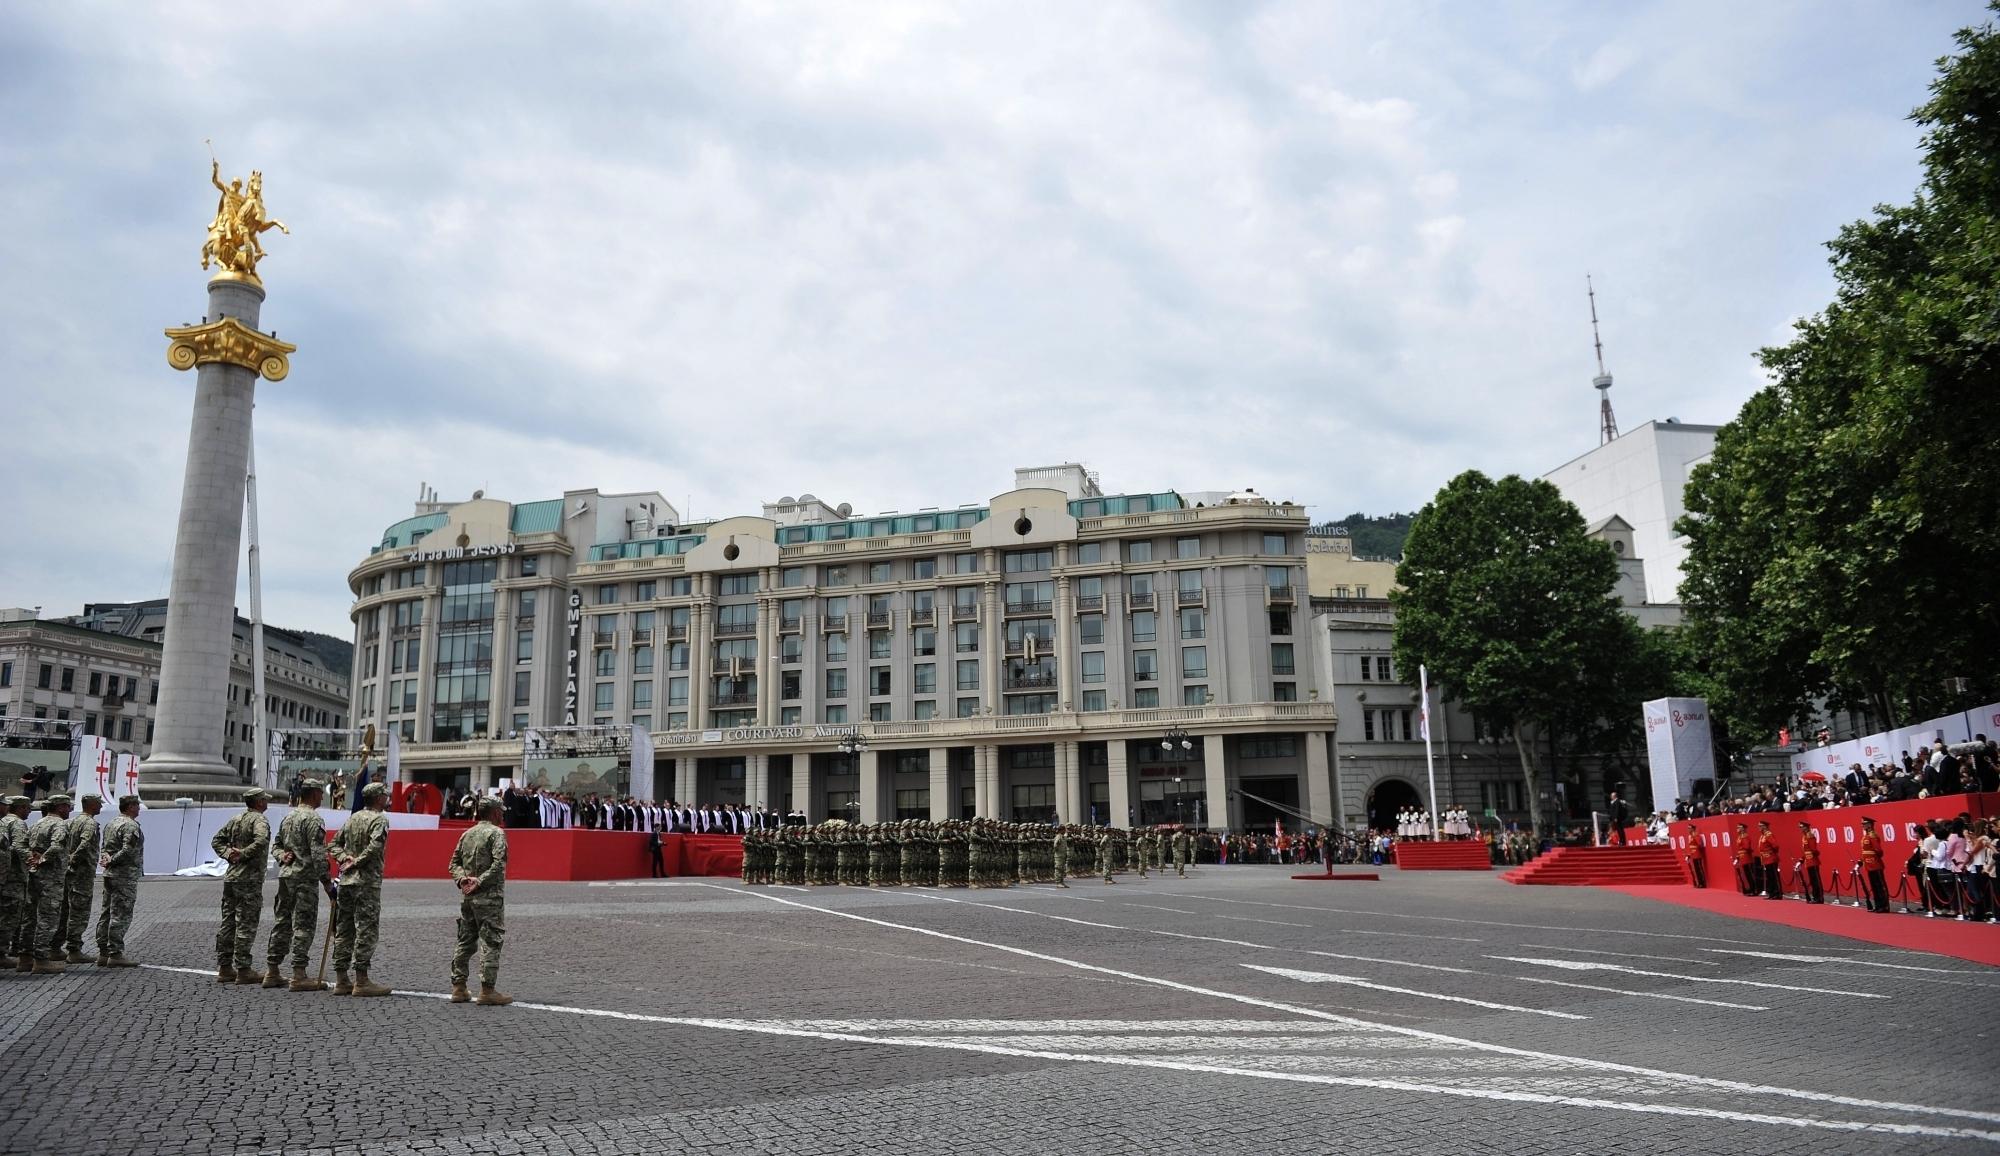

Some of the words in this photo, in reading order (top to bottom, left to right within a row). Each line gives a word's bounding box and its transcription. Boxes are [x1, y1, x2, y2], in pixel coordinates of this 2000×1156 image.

[1304, 523, 1348, 536] adines
[567, 594, 580, 637] GMT
[564, 649, 578, 725] PLAZA
[728, 727, 803, 741] COURTYARD
